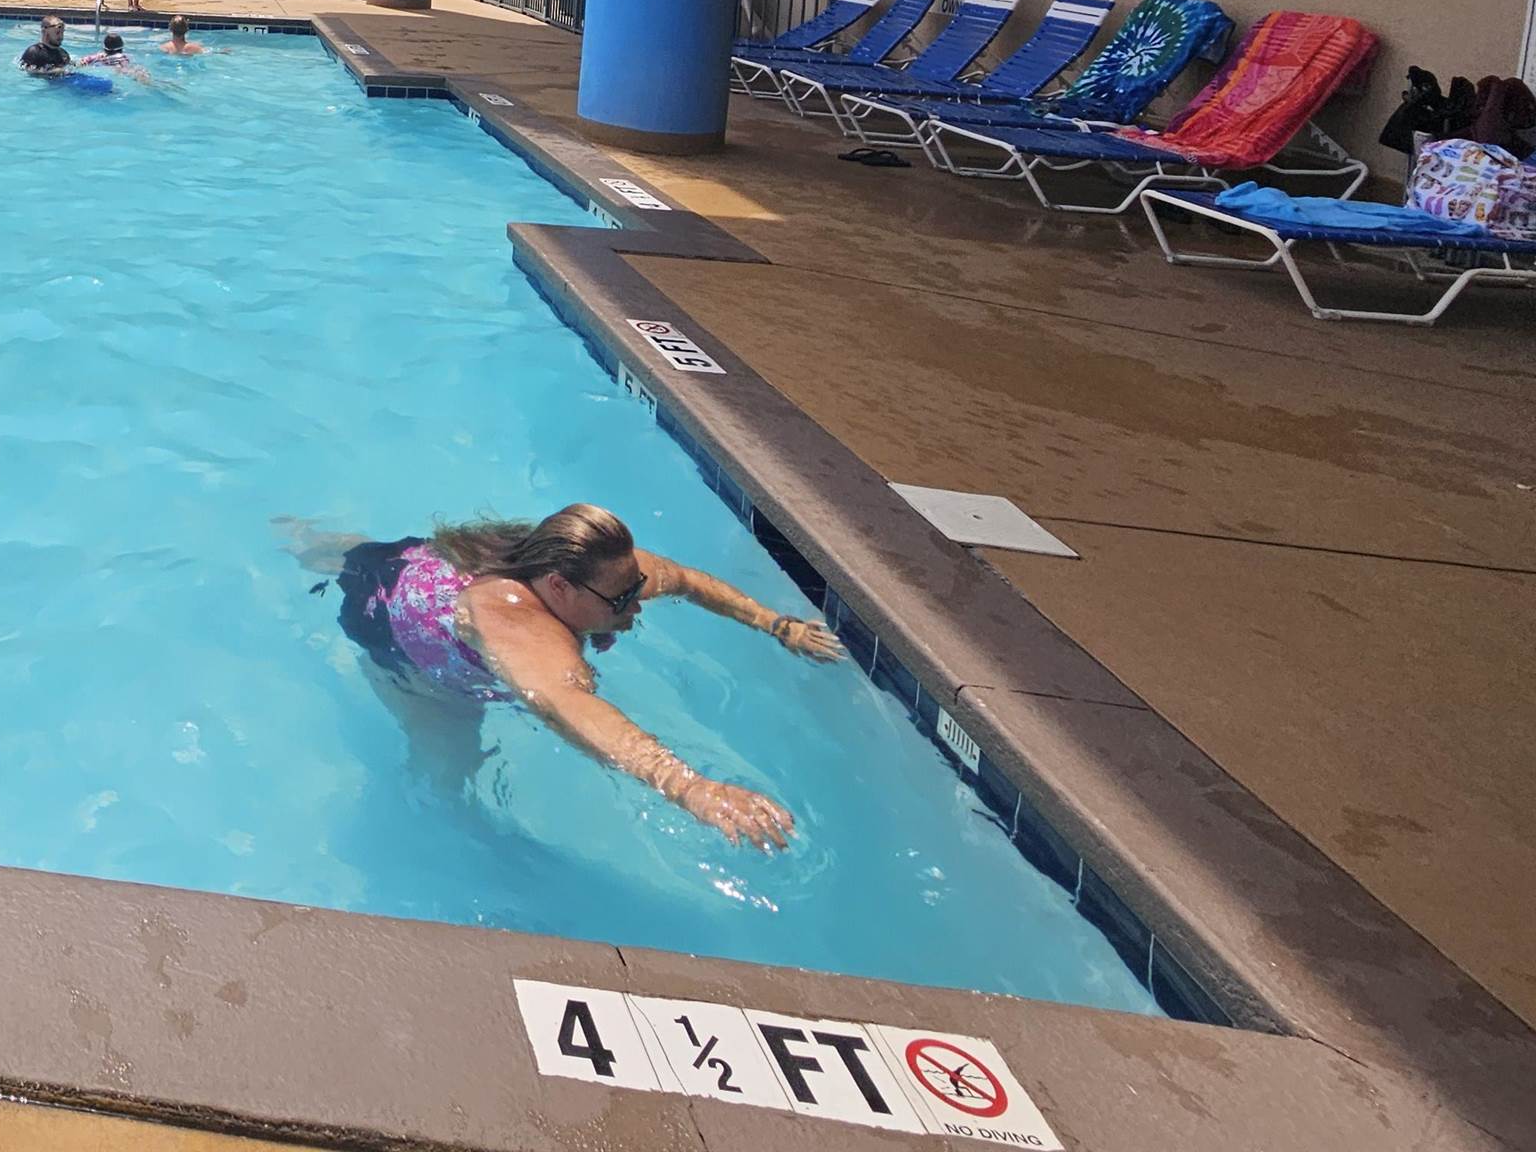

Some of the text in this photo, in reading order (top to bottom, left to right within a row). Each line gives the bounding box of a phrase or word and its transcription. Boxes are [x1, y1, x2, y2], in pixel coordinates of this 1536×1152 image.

[650, 335, 712, 368] 5 FT
[624, 374, 633, 394] 5
[557, 999, 615, 1077] 4
[757, 1022, 892, 1115] FT
[944, 1122, 1044, 1146] NO DIVING
